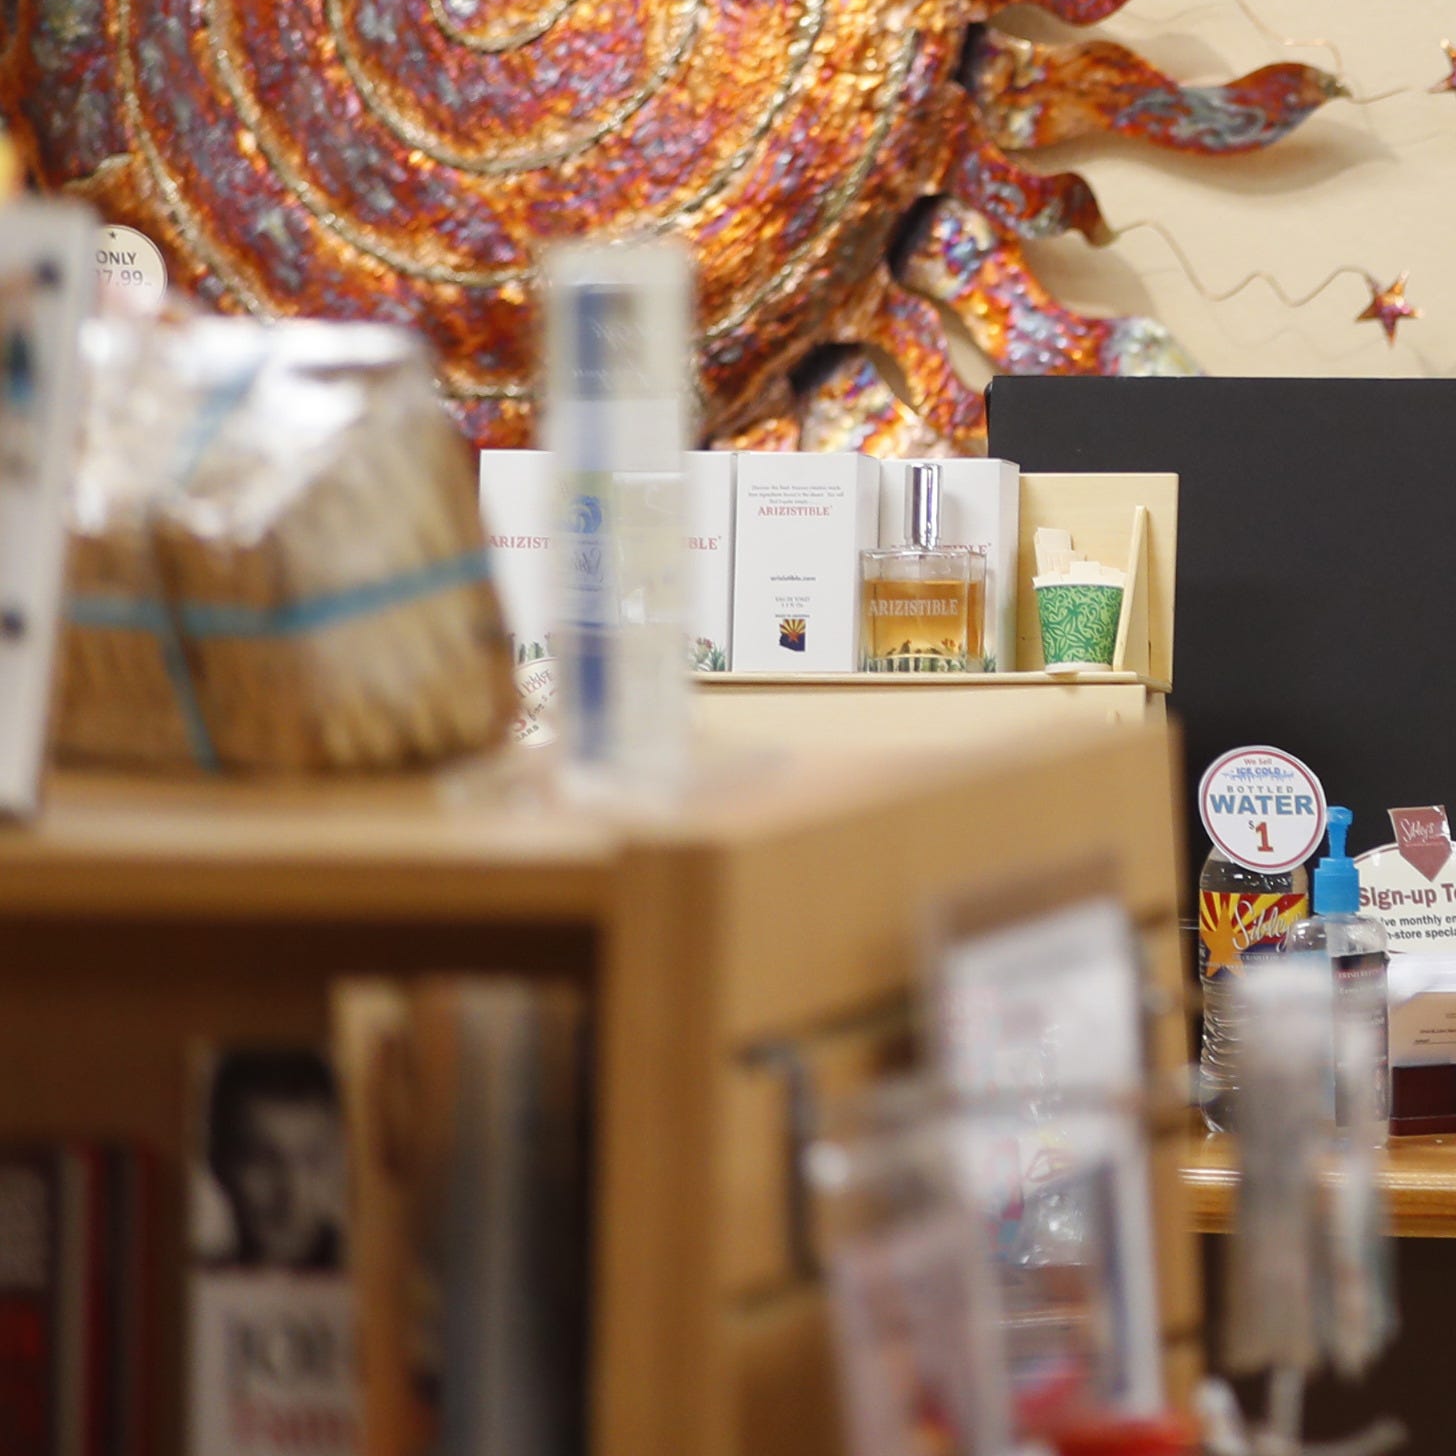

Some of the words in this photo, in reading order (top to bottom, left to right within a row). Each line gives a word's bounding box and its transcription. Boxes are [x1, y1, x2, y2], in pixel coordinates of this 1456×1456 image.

[95, 249, 137, 265] ONLY
[758, 506, 832, 516] ARIZISTIBLE
[489, 535, 551, 550] ARIZIST
[868, 599, 958, 616] ARIZISTIBLE
[1210, 794, 1315, 815] WATER
[1248, 820, 1274, 852] $1
[1359, 884, 1437, 910] Sign-up
[1233, 899, 1291, 952] Sibley
[1400, 915, 1442, 926] monthly
[1386, 930, 1422, 940] n-store
